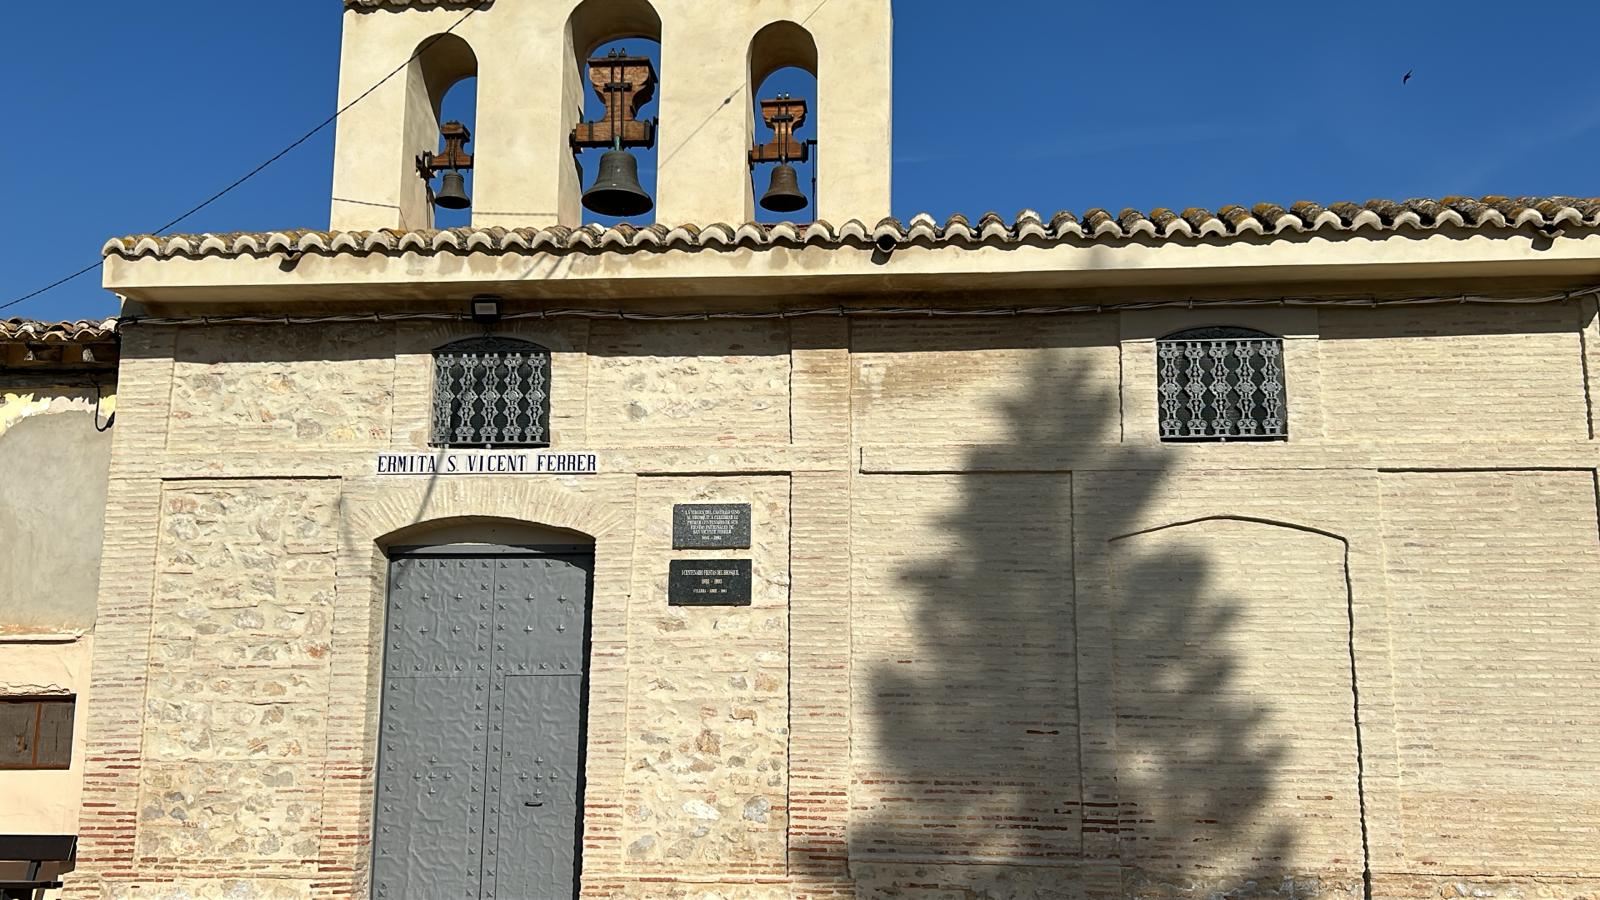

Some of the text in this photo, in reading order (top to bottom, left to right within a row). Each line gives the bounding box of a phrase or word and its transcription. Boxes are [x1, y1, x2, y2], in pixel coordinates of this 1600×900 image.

[377, 455, 437, 472] ERMITA
[468, 454, 527, 472] VICENT
[537, 454, 597, 472] FERRER
